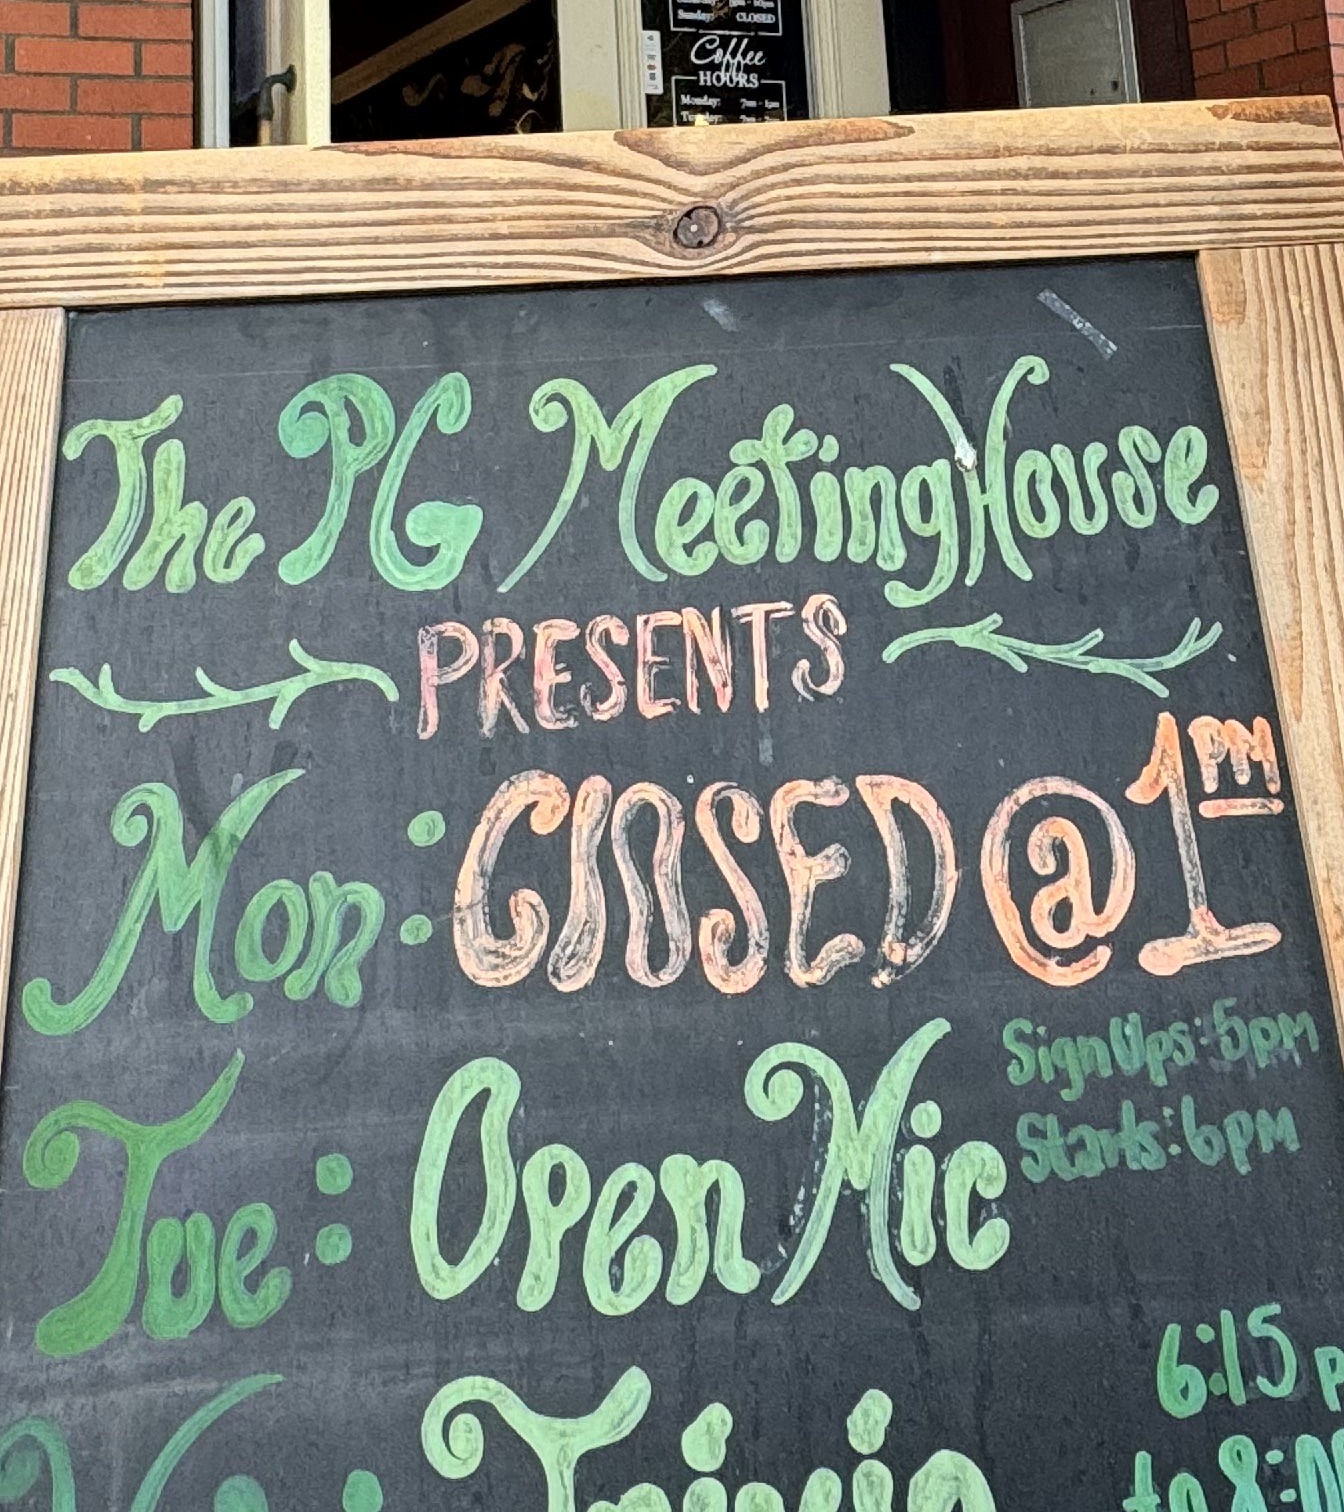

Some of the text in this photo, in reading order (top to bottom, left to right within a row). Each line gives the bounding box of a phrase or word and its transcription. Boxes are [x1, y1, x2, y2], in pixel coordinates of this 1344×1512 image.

[690, 34, 766, 82] Coffee
[698, 70, 759, 88] HOURS
[62, 354, 1220, 609] The PG MeetingHouse
[415, 592, 850, 739] PRESENTS
[22, 767, 446, 1036] Mon:
[411, 1056, 760, 1316] Open
[744, 1017, 1012, 1310] Mic
[1156, 1302, 1298, 1419] 6:15
